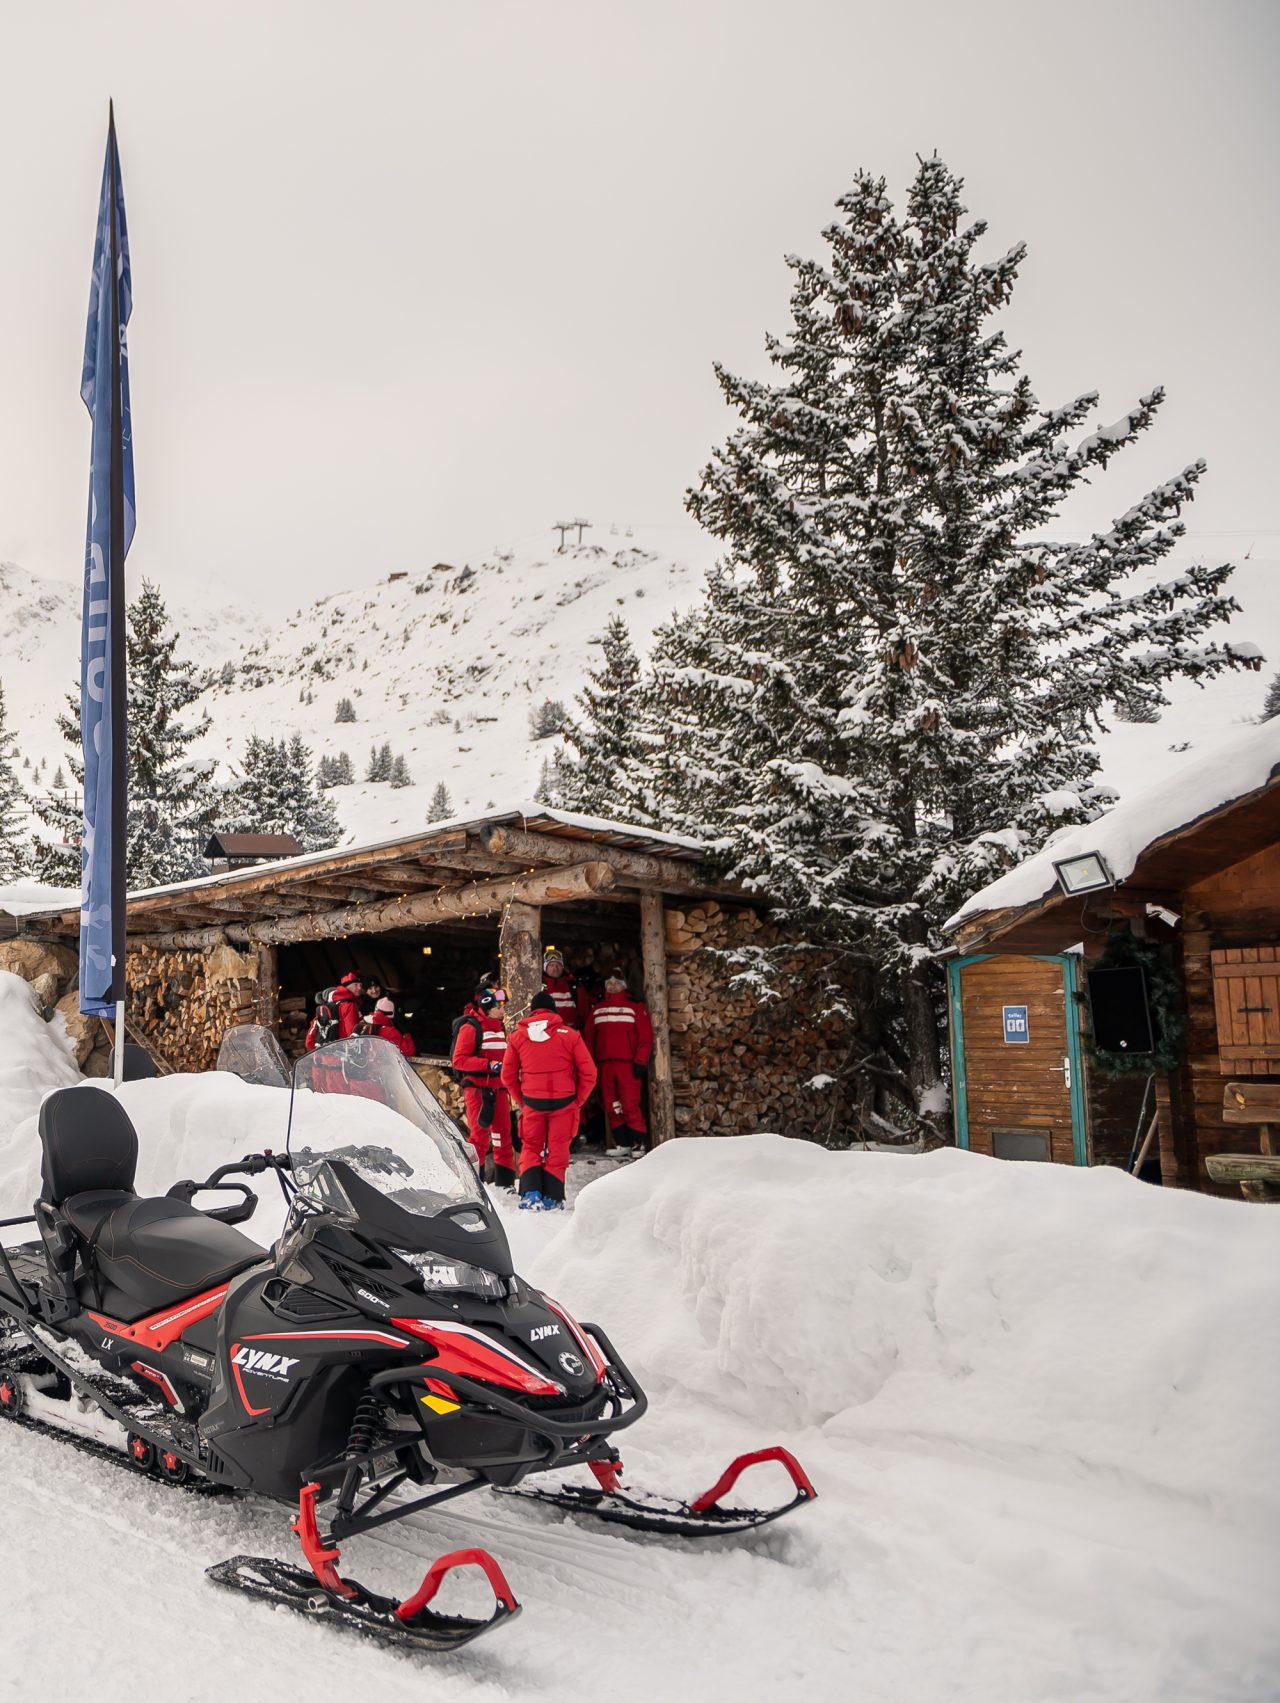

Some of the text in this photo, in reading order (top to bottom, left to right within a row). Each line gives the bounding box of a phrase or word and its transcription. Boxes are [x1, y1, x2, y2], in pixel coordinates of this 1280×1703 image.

[530, 1324, 560, 1341] LYNX
[101, 1337, 114, 1350] LX
[231, 1347, 300, 1375] LYNX
[242, 1367, 290, 1383] ADVENTURE
